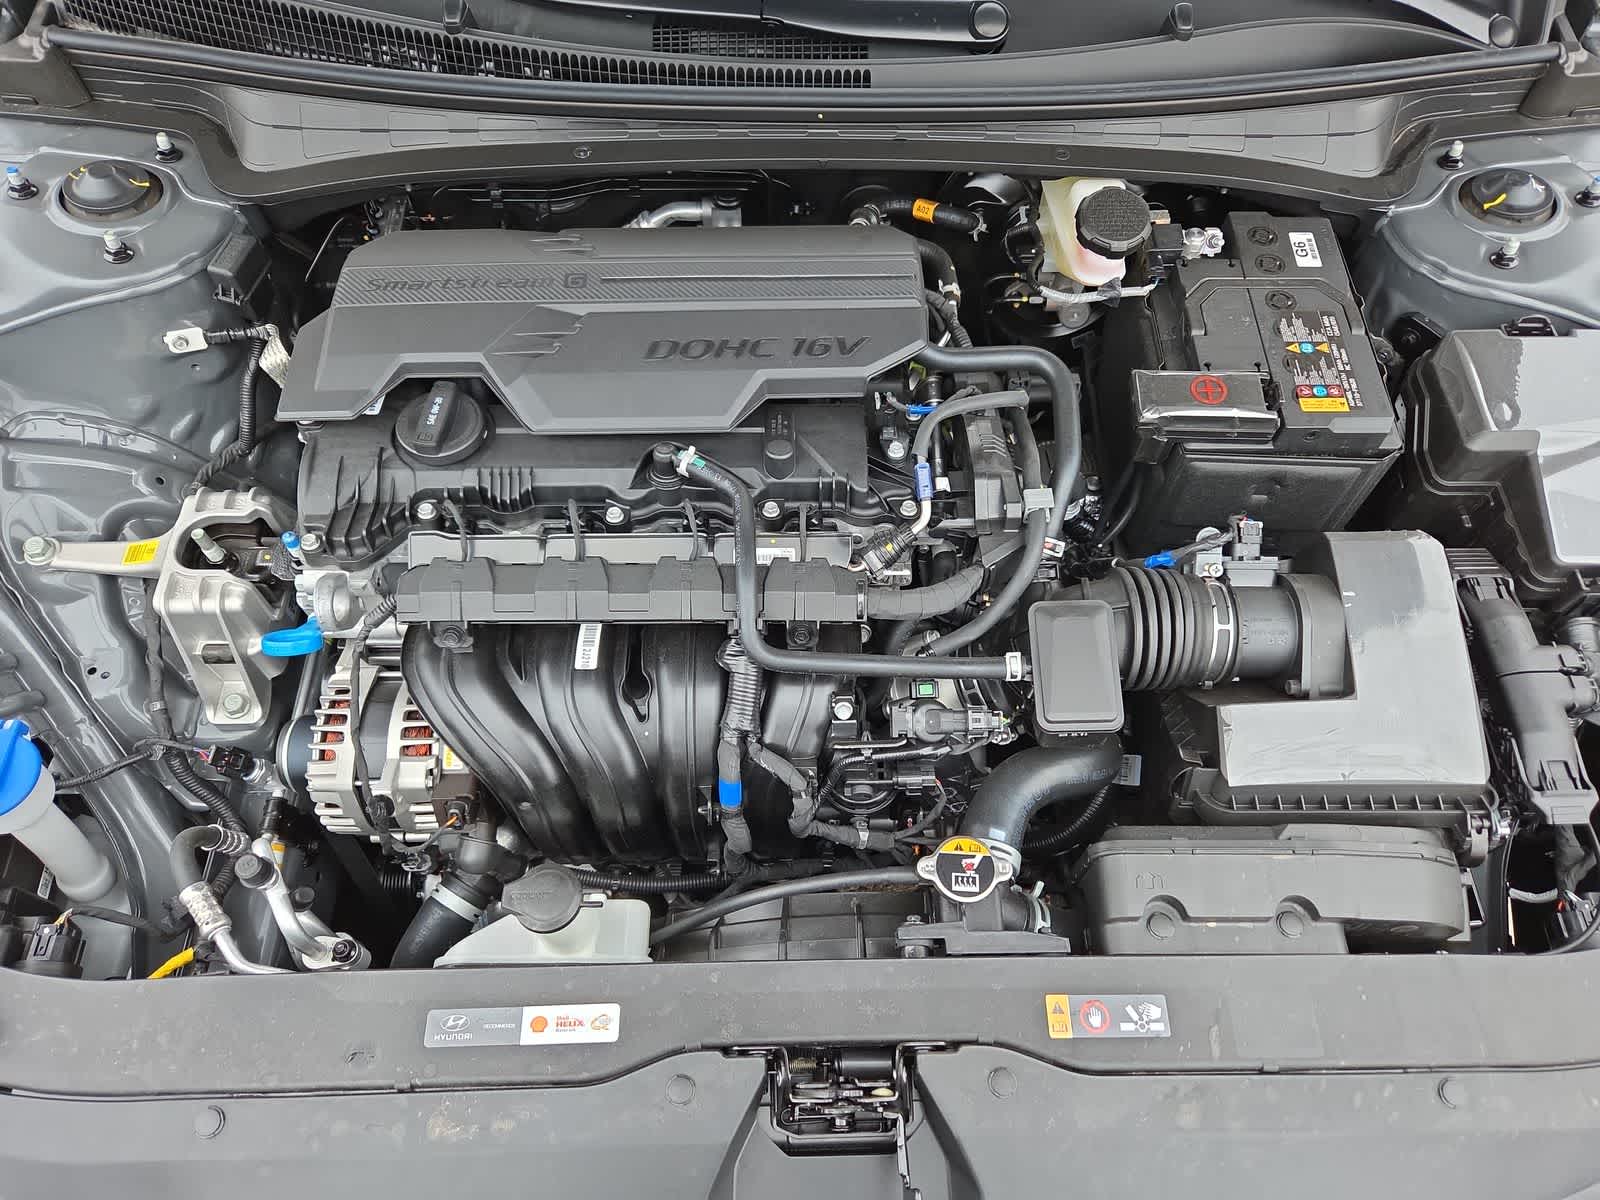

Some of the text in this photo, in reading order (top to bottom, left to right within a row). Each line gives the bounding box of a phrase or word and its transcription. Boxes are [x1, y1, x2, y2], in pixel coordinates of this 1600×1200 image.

[1293, 241, 1309, 258] G6
[360, 277, 552, 293] Smartstream
[643, 335, 872, 361] DOHC 16V
[426, 414, 438, 425] SAE
[555, 1019, 586, 1028] HELIX
[433, 1032, 473, 1041] HYUNDAI
